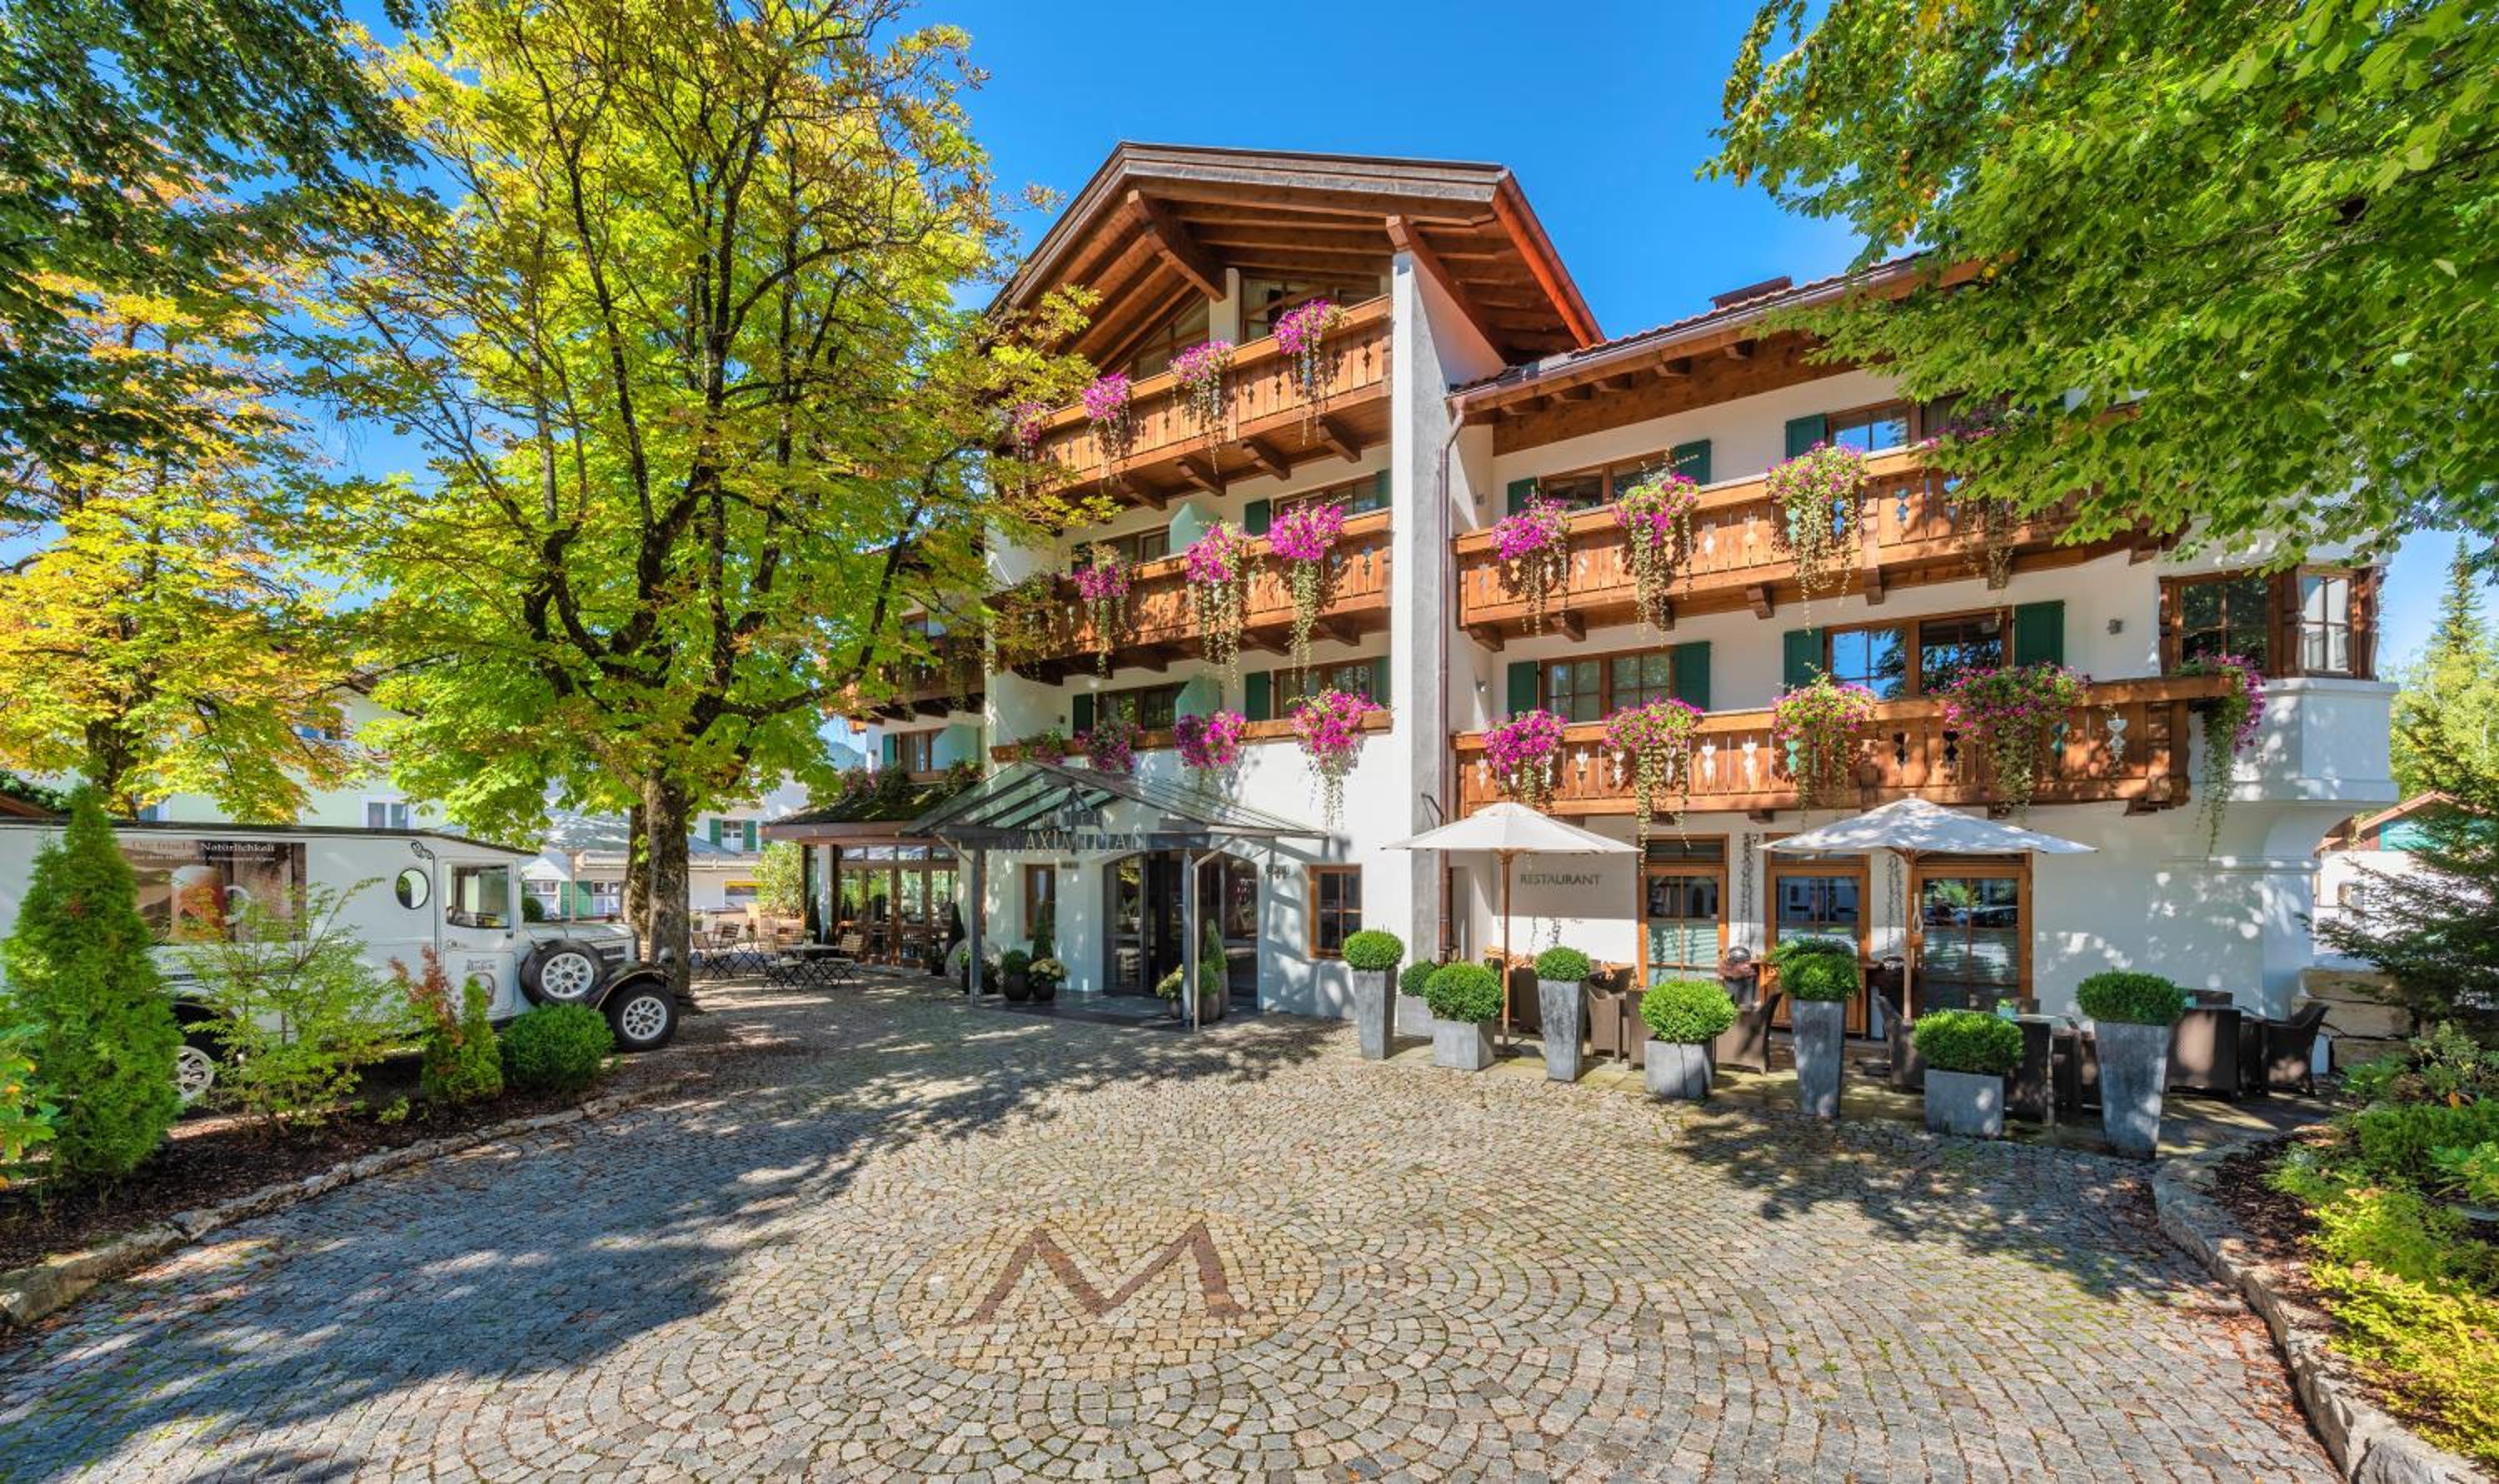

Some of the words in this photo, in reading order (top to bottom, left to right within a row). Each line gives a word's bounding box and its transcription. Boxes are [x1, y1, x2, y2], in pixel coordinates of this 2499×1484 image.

[200, 842, 275, 852] Natürlichkeit
[1002, 830, 1147, 853] MAXIMILIAN
[1519, 874, 1600, 885] RESTAURANT
